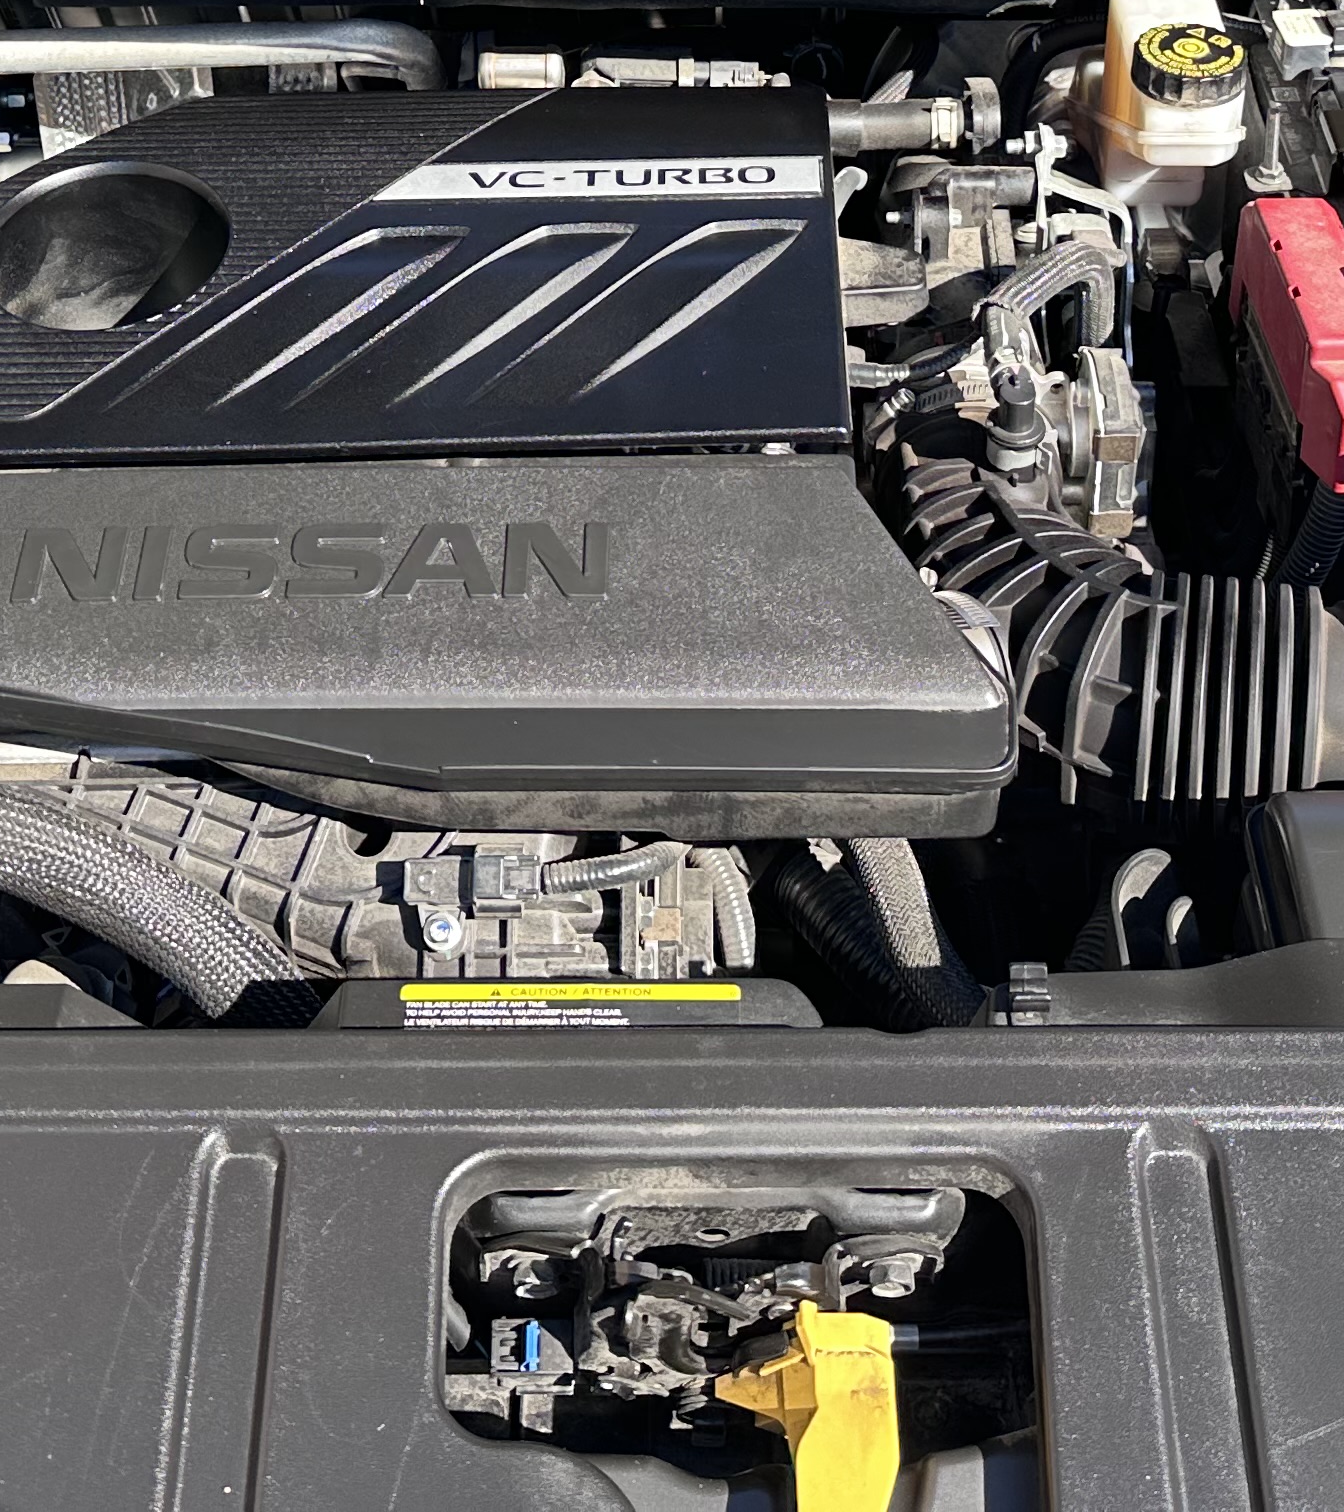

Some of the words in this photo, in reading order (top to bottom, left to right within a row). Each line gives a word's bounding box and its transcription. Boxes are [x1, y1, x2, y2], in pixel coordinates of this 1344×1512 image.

[468, 164, 776, 190] VC-TURBO
[9, 522, 610, 603] NISSAN
[510, 987, 567, 996] CAUTION
[582, 987, 652, 996] ATTENTION
